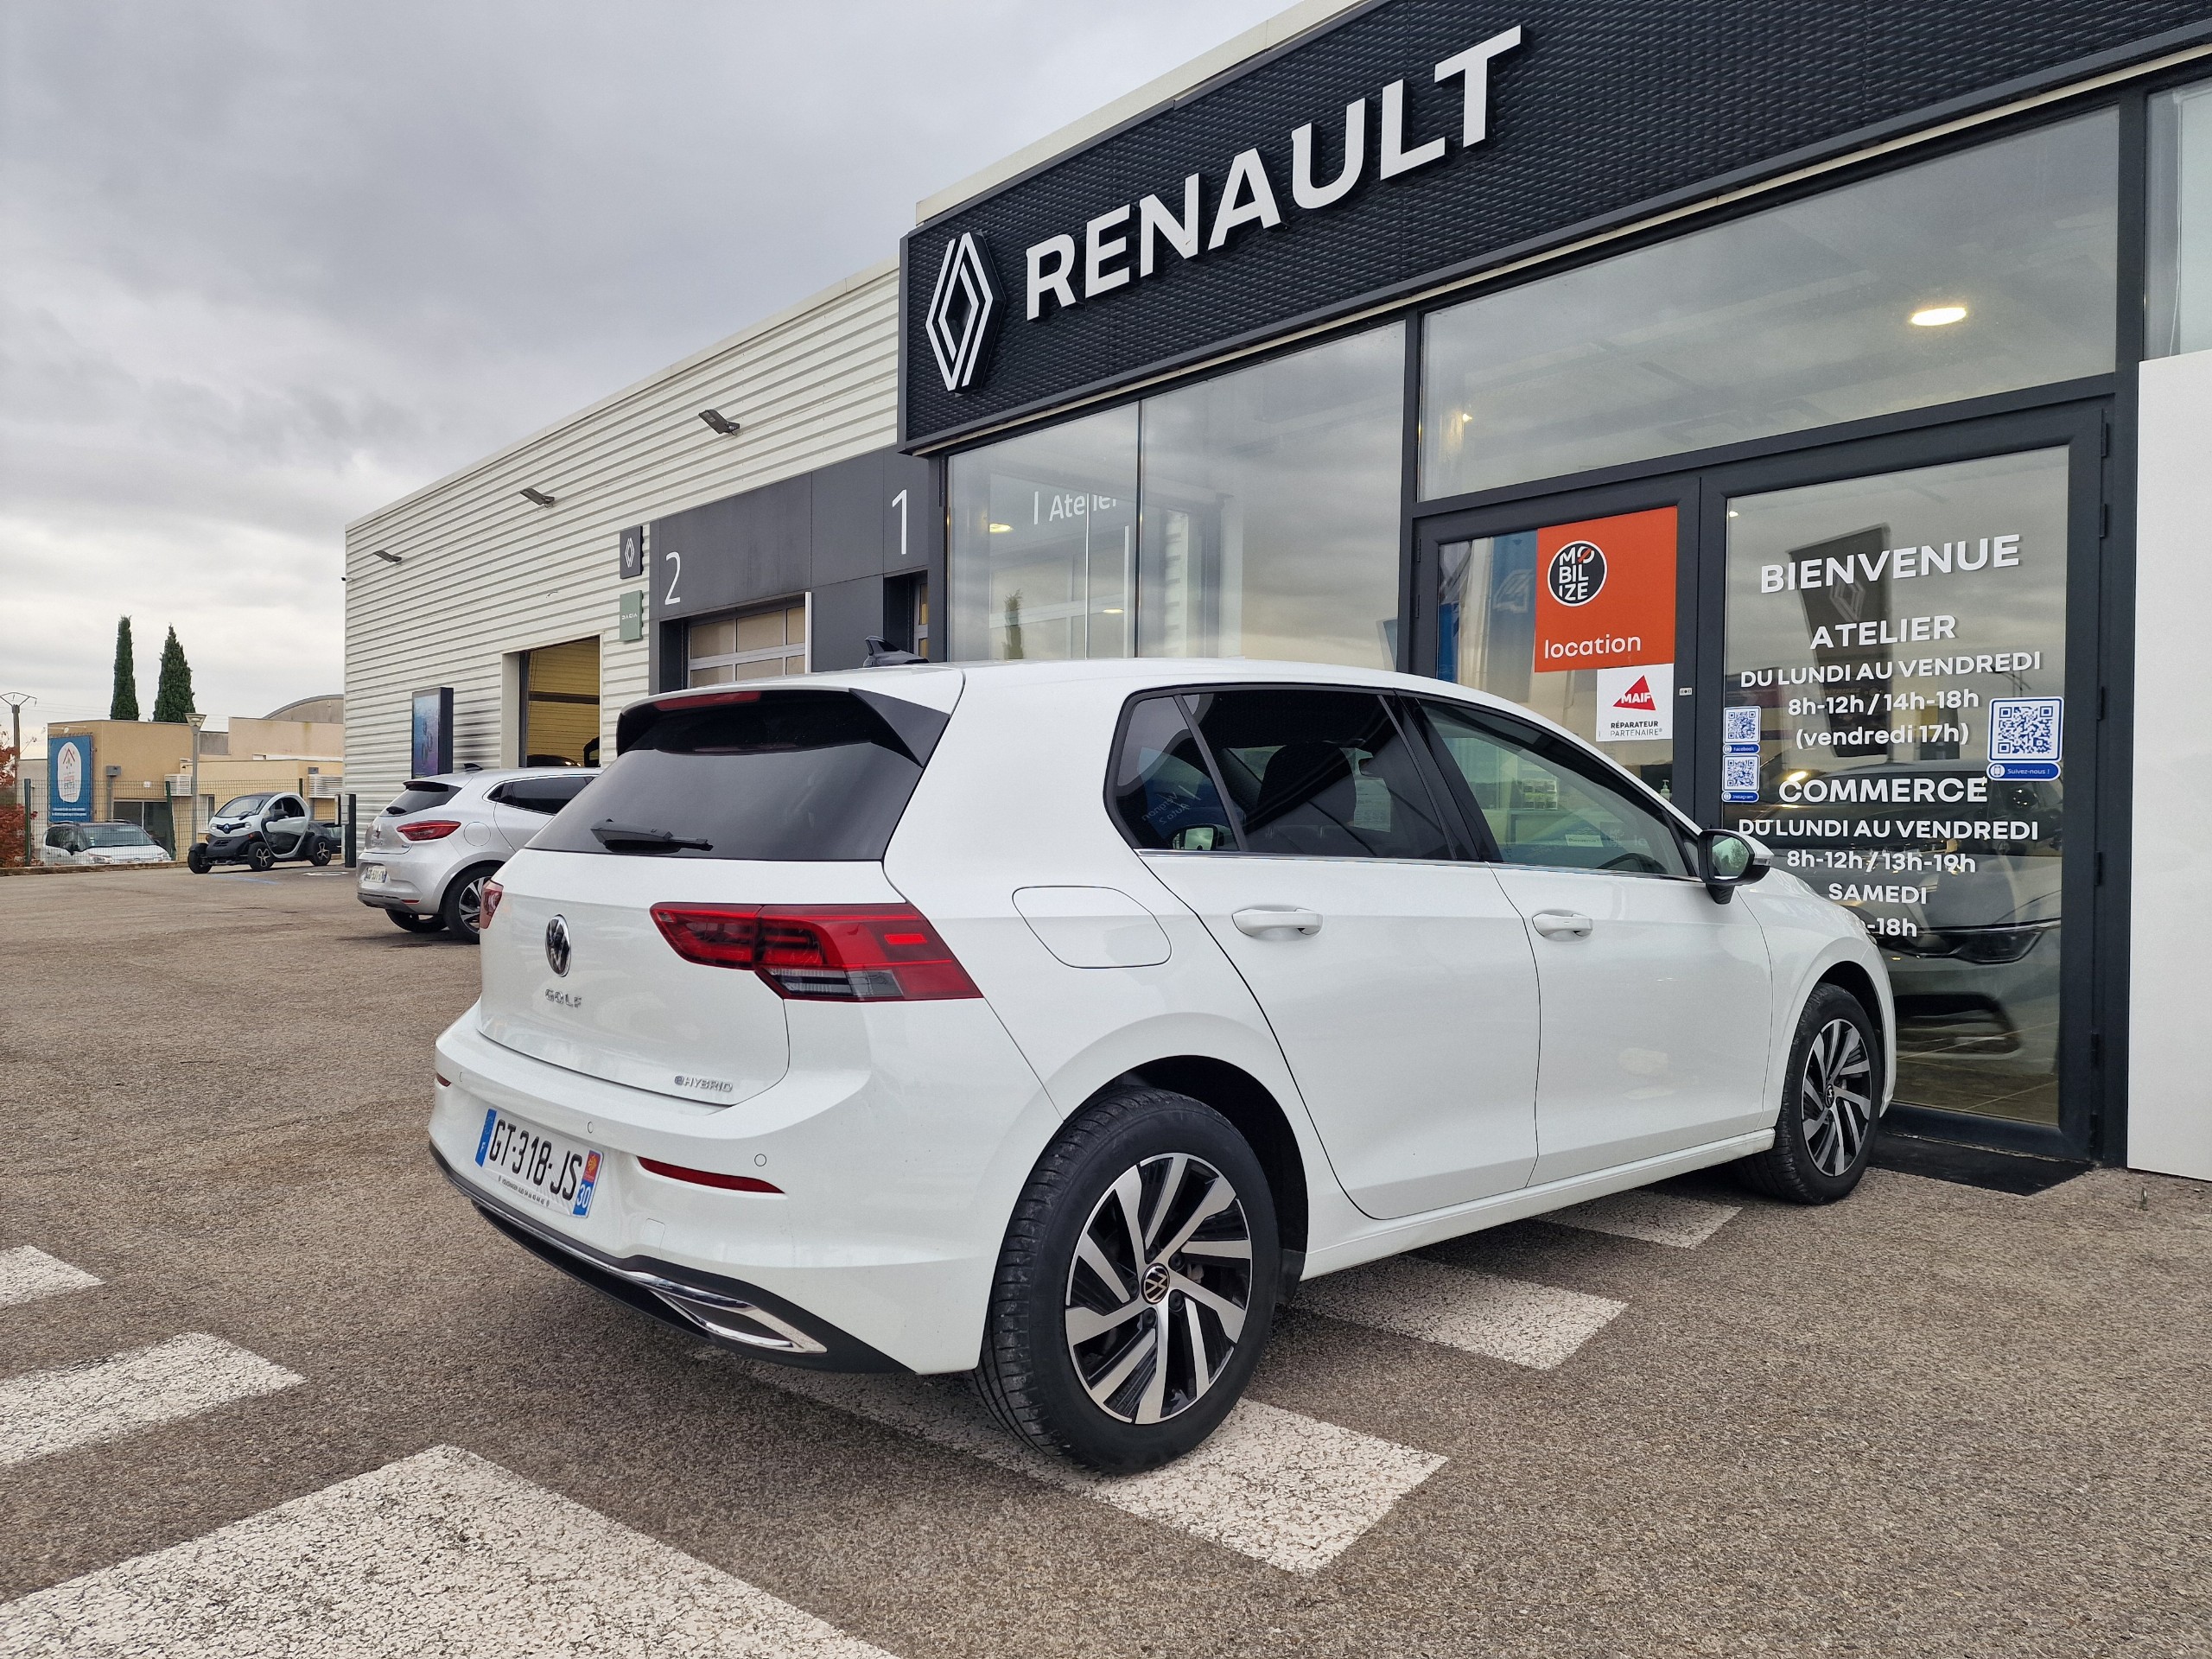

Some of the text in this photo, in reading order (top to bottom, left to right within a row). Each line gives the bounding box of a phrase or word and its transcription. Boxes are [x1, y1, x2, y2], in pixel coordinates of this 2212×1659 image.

[1026, 24, 1522, 321] RENAULT
[892, 489, 907, 555] 1
[1761, 534, 2020, 594] BIENVENUE
[664, 551, 681, 605] 2
[1809, 614, 1957, 650] ATELIER
[1544, 633, 1641, 659] location
[1740, 651, 2041, 688] DU LUNDI AU VENDREDI
[1621, 692, 1651, 704] MAIF
[1788, 696, 1865, 715] 8h-12h
[1884, 689, 1979, 711] 14h-18h
[1611, 721, 1658, 729] RÉPARATEUR
[1796, 722, 1969, 749] (vendredi 17h)
[1778, 777, 1987, 804] COMMERCE
[1738, 819, 2038, 840] DU LUNDI AU VENDREDI
[1787, 851, 1863, 869] 8h-12h
[1884, 852, 1976, 873] 13h-19h
[1828, 883, 1927, 905] SAMEDI
[545, 988, 582, 1008] GOLF
[489, 1118, 582, 1201] GT-318-JS
[576, 1184, 592, 1209] 30
